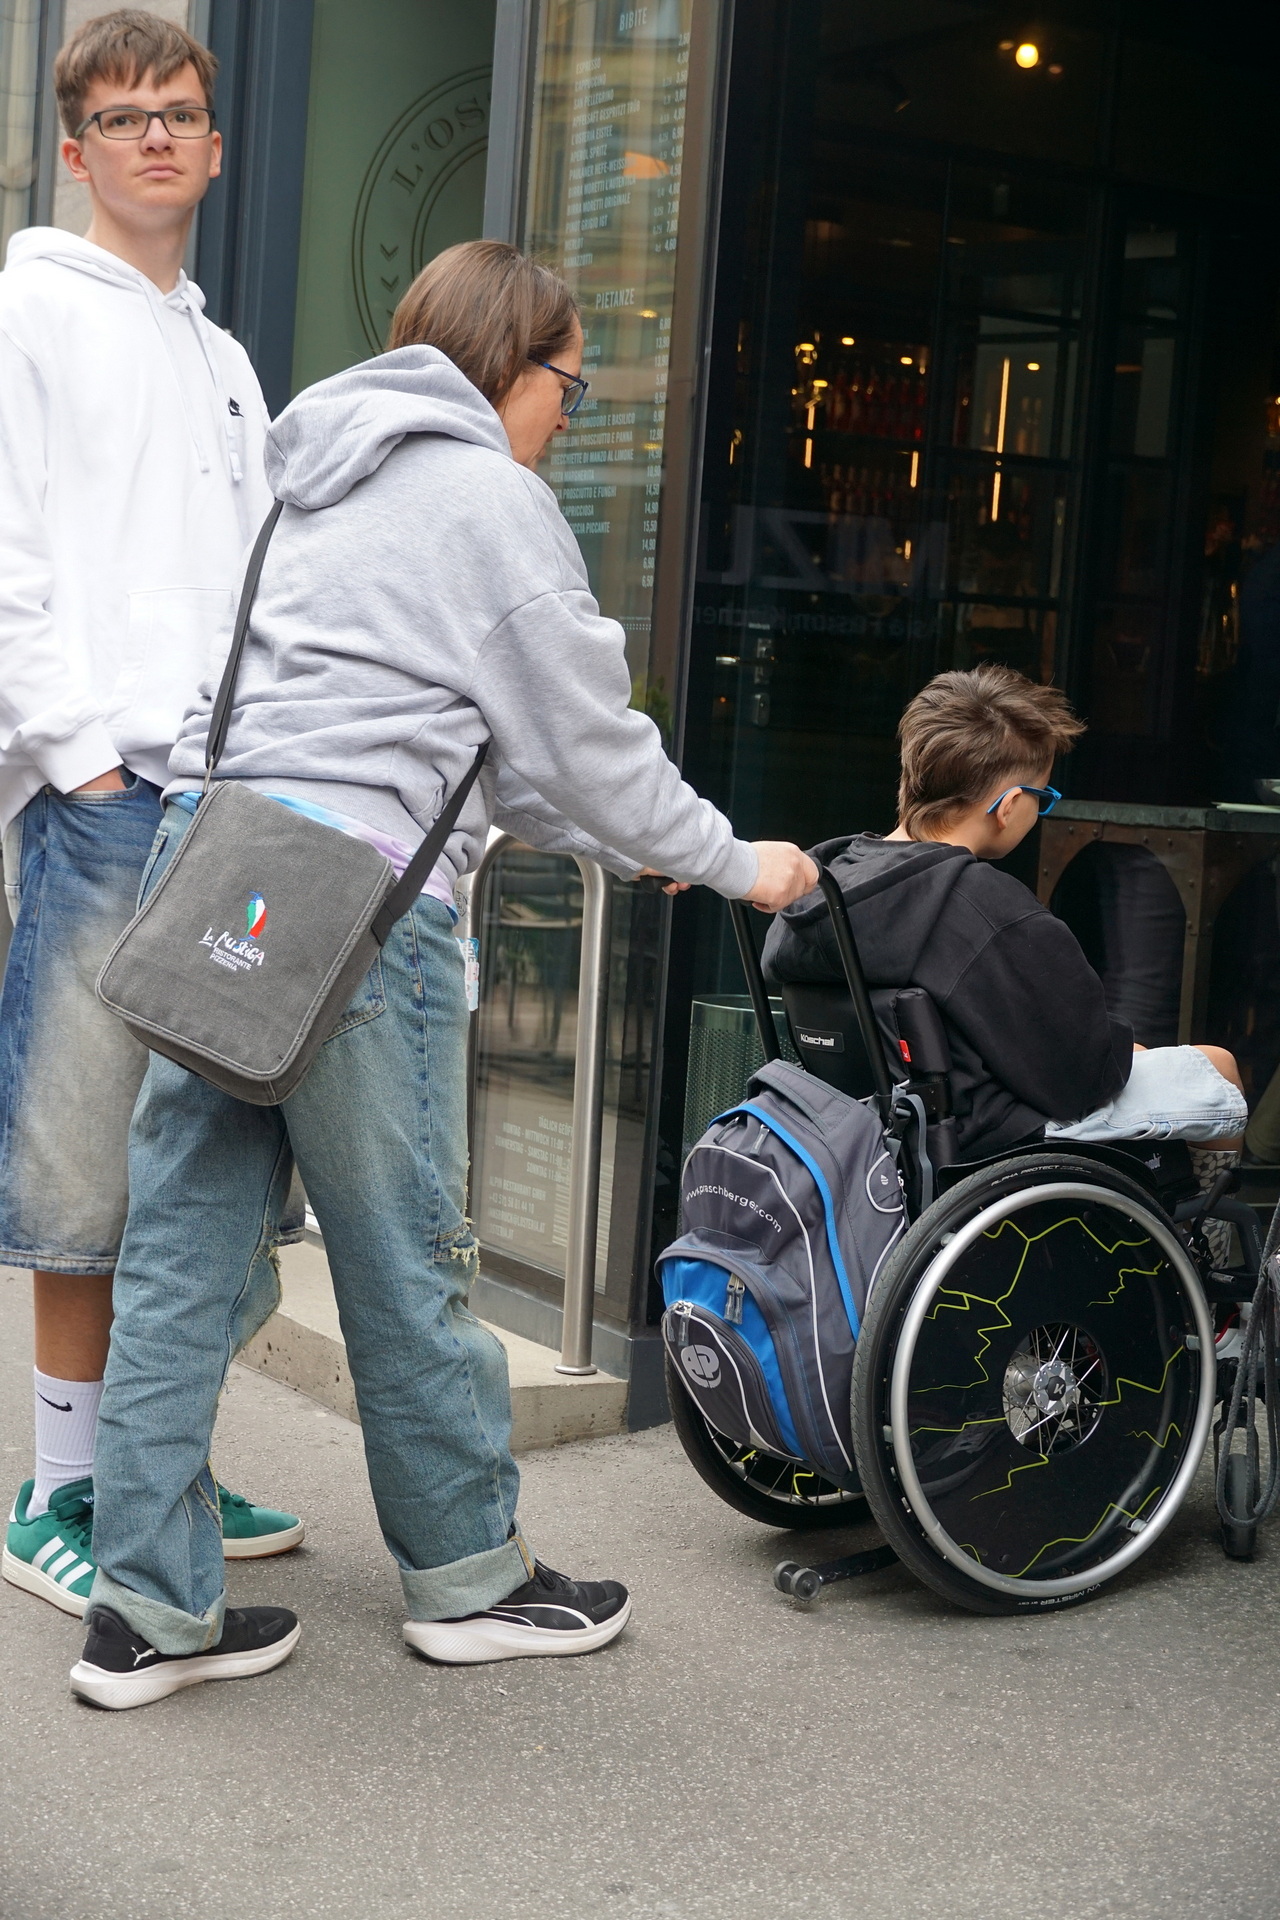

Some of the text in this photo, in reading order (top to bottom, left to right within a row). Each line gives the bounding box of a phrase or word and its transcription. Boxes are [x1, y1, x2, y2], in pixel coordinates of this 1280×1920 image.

[619, 7, 648, 32] BIBITE
[390, 97, 487, 196] L'OS
[589, 144, 607, 159] SPRITZ
[595, 288, 635, 310] PIETANZE
[607, 415, 611, 426] E
[612, 413, 635, 425] BASILICO
[580, 433, 610, 447] PROSCIUTTO
[611, 432, 615, 443] E
[607, 450, 613, 461] AL
[562, 487, 592, 499] PROSCIUTTO
[593, 486, 597, 498] E
[646, 483, 660, 496] 14,50
[643, 520, 657, 533] 15,50
[642, 538, 656, 551] 14,90
[641, 575, 654, 588] 6,50
[209, 953, 238, 971] PIZZERIA
[213, 947, 252, 971] RISTORANTE
[538, 1115, 558, 1134] TÄGLICH
[503, 1121, 521, 1137] MONTAG
[525, 1128, 550, 1146] MITTWOCH
[495, 1135, 524, 1154] DONNERSTAG
[527, 1145, 549, 1162] SAMSTAG
[526, 1162, 548, 1178] SONNTAG
[503, 1179, 532, 1197] RESTAURANT
[1053, 1383, 1065, 1395] K
[1040, 1590, 1085, 1606] MASTER
